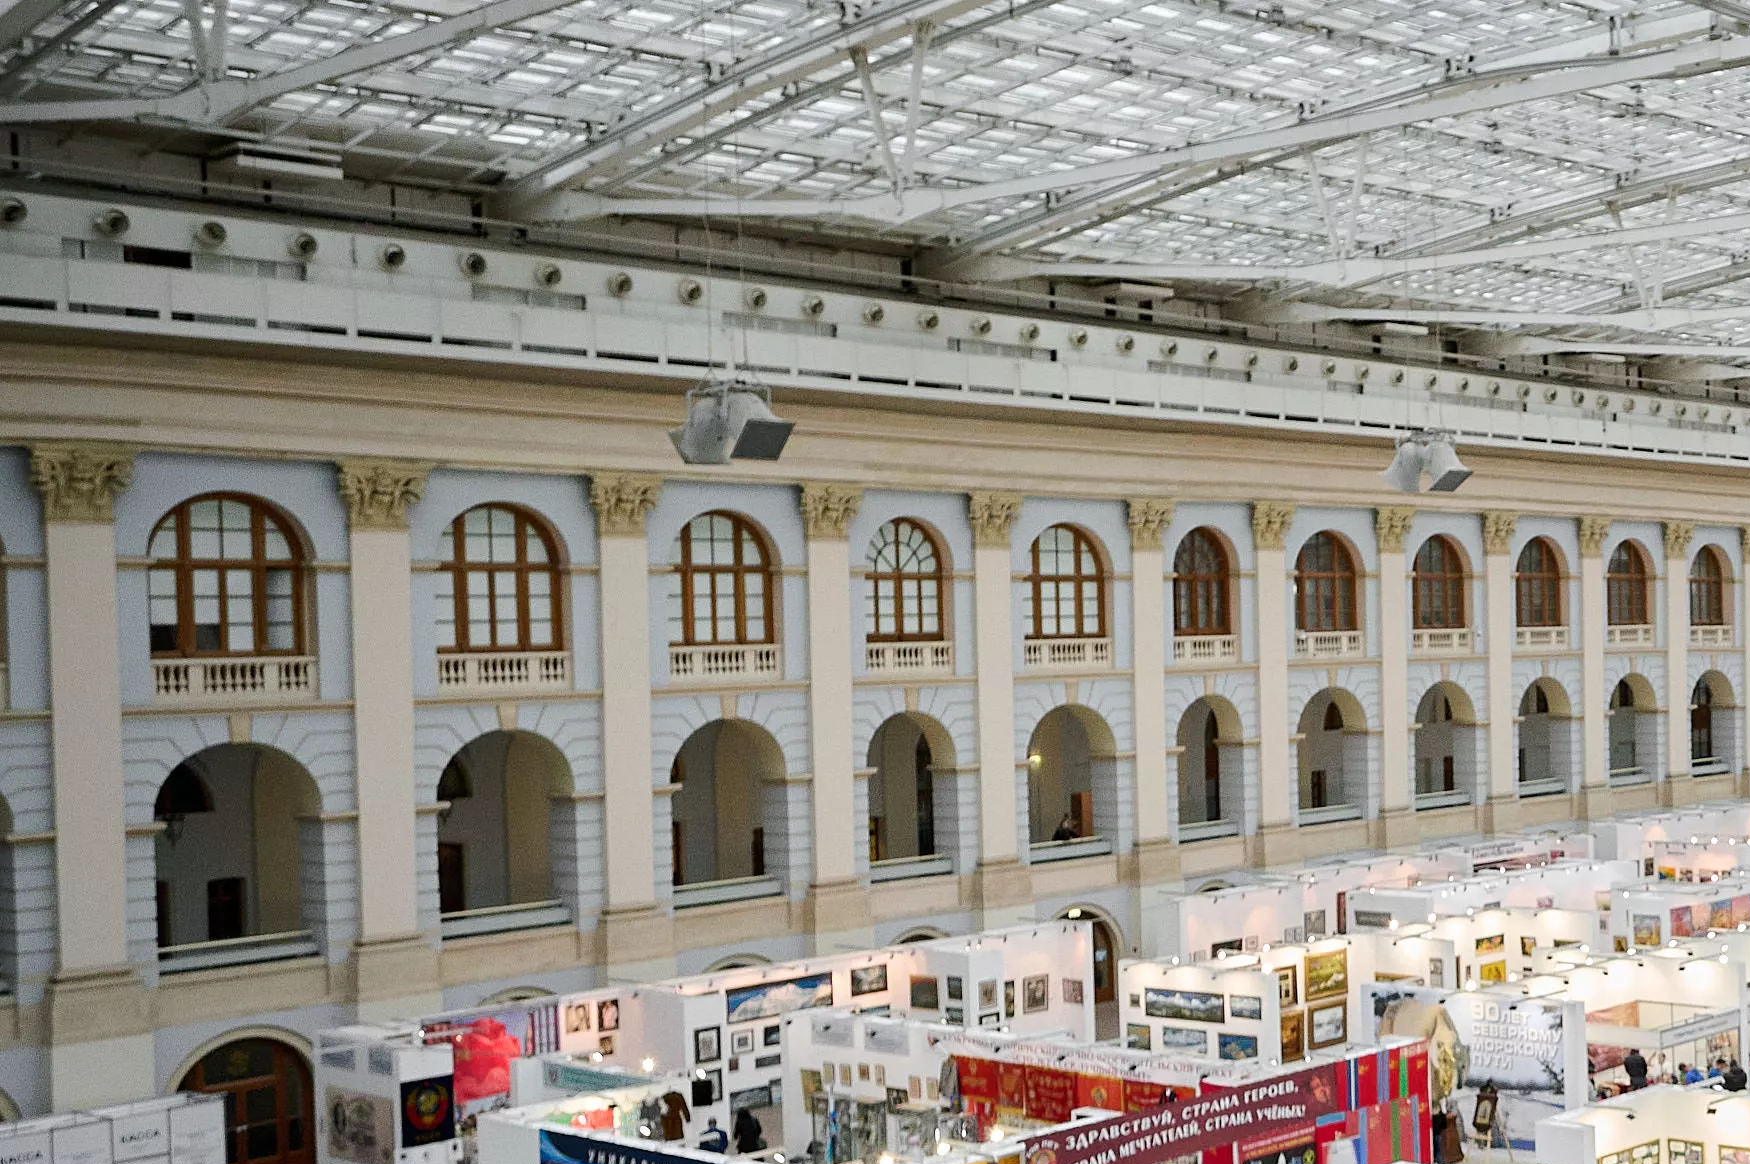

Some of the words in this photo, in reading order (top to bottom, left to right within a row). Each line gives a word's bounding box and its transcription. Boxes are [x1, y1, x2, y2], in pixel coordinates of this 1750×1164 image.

[1471, 1023, 1563, 1044] СЕВЕРНОМУ
[1472, 1039, 1558, 1060] МОРСКОМУ
[1472, 1053, 1513, 1070] ПУТИ
[1181, 1095, 1240, 1120] СТРАНА
[1205, 1110, 1253, 1133] СТРАНА
[1256, 1104, 1306, 1121] УЧЁНЫХ!
